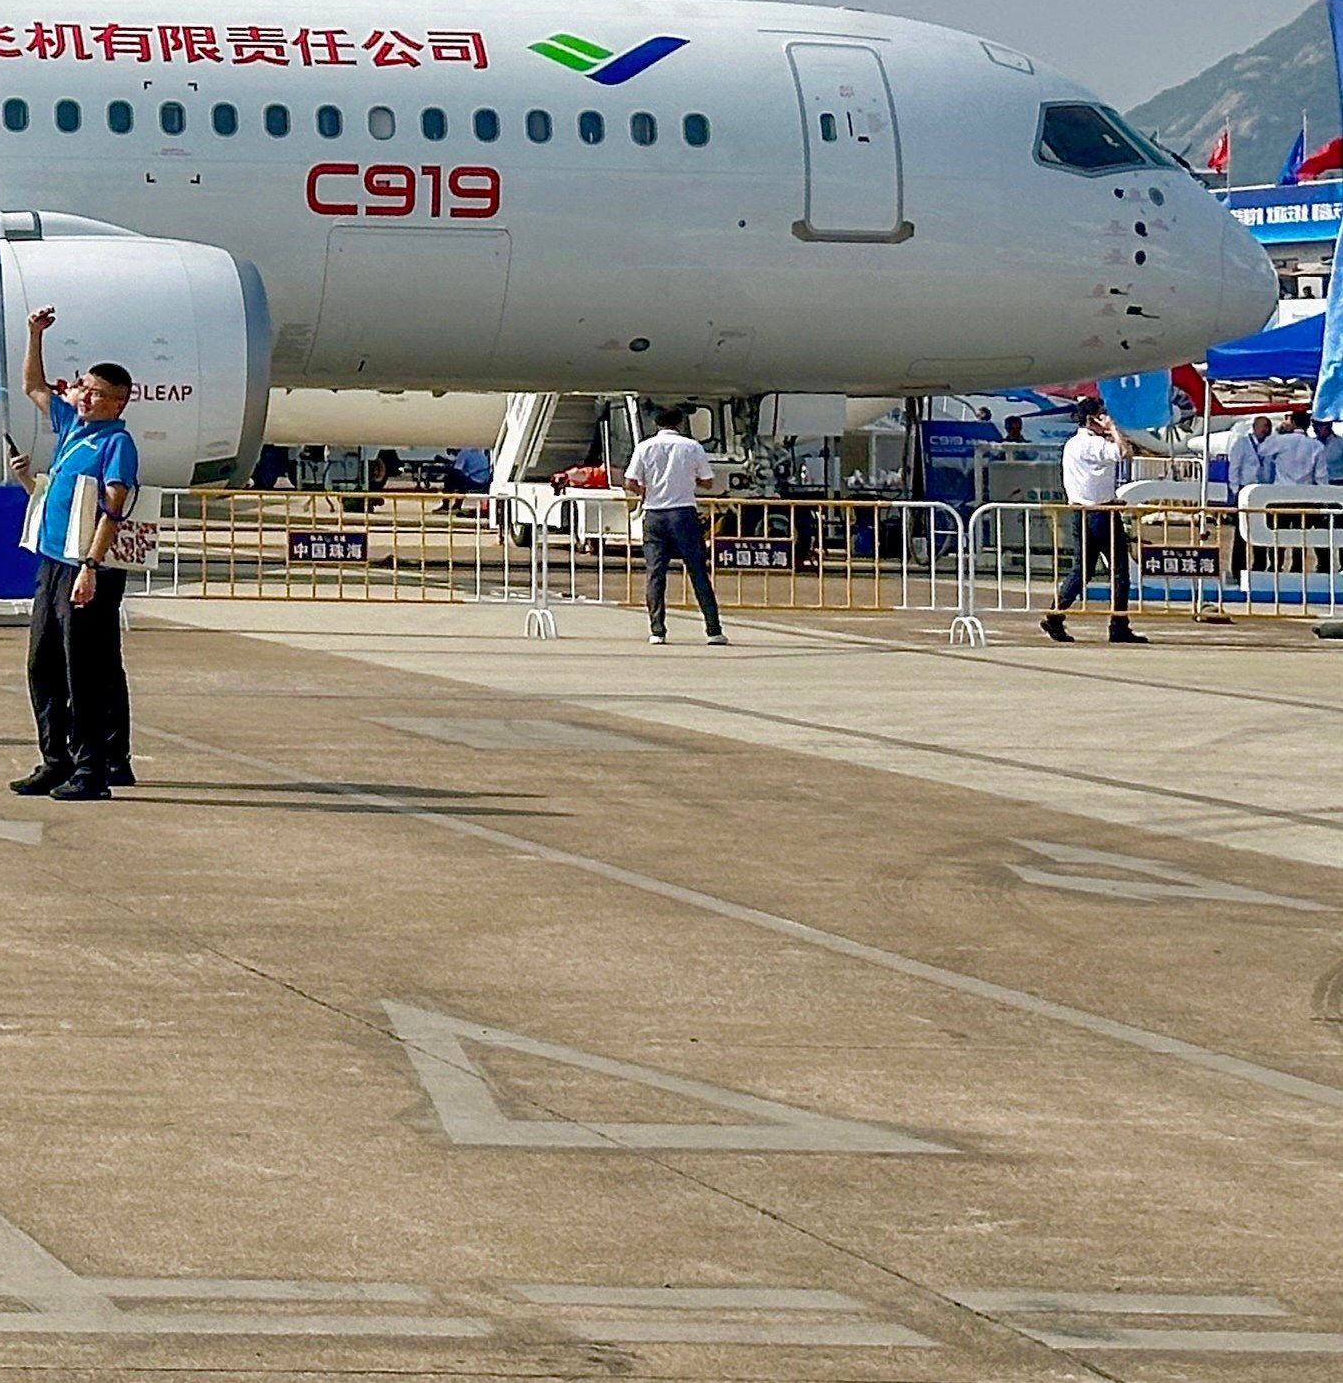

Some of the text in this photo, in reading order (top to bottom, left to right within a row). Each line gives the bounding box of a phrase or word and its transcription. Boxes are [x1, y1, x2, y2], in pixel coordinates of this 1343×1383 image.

[306, 162, 501, 218] C919
[143, 384, 193, 401] LEAP
[293, 542, 363, 559] 中国珠海
[718, 549, 788, 567] 中国珠海
[1145, 556, 1215, 574] 中国珠海
